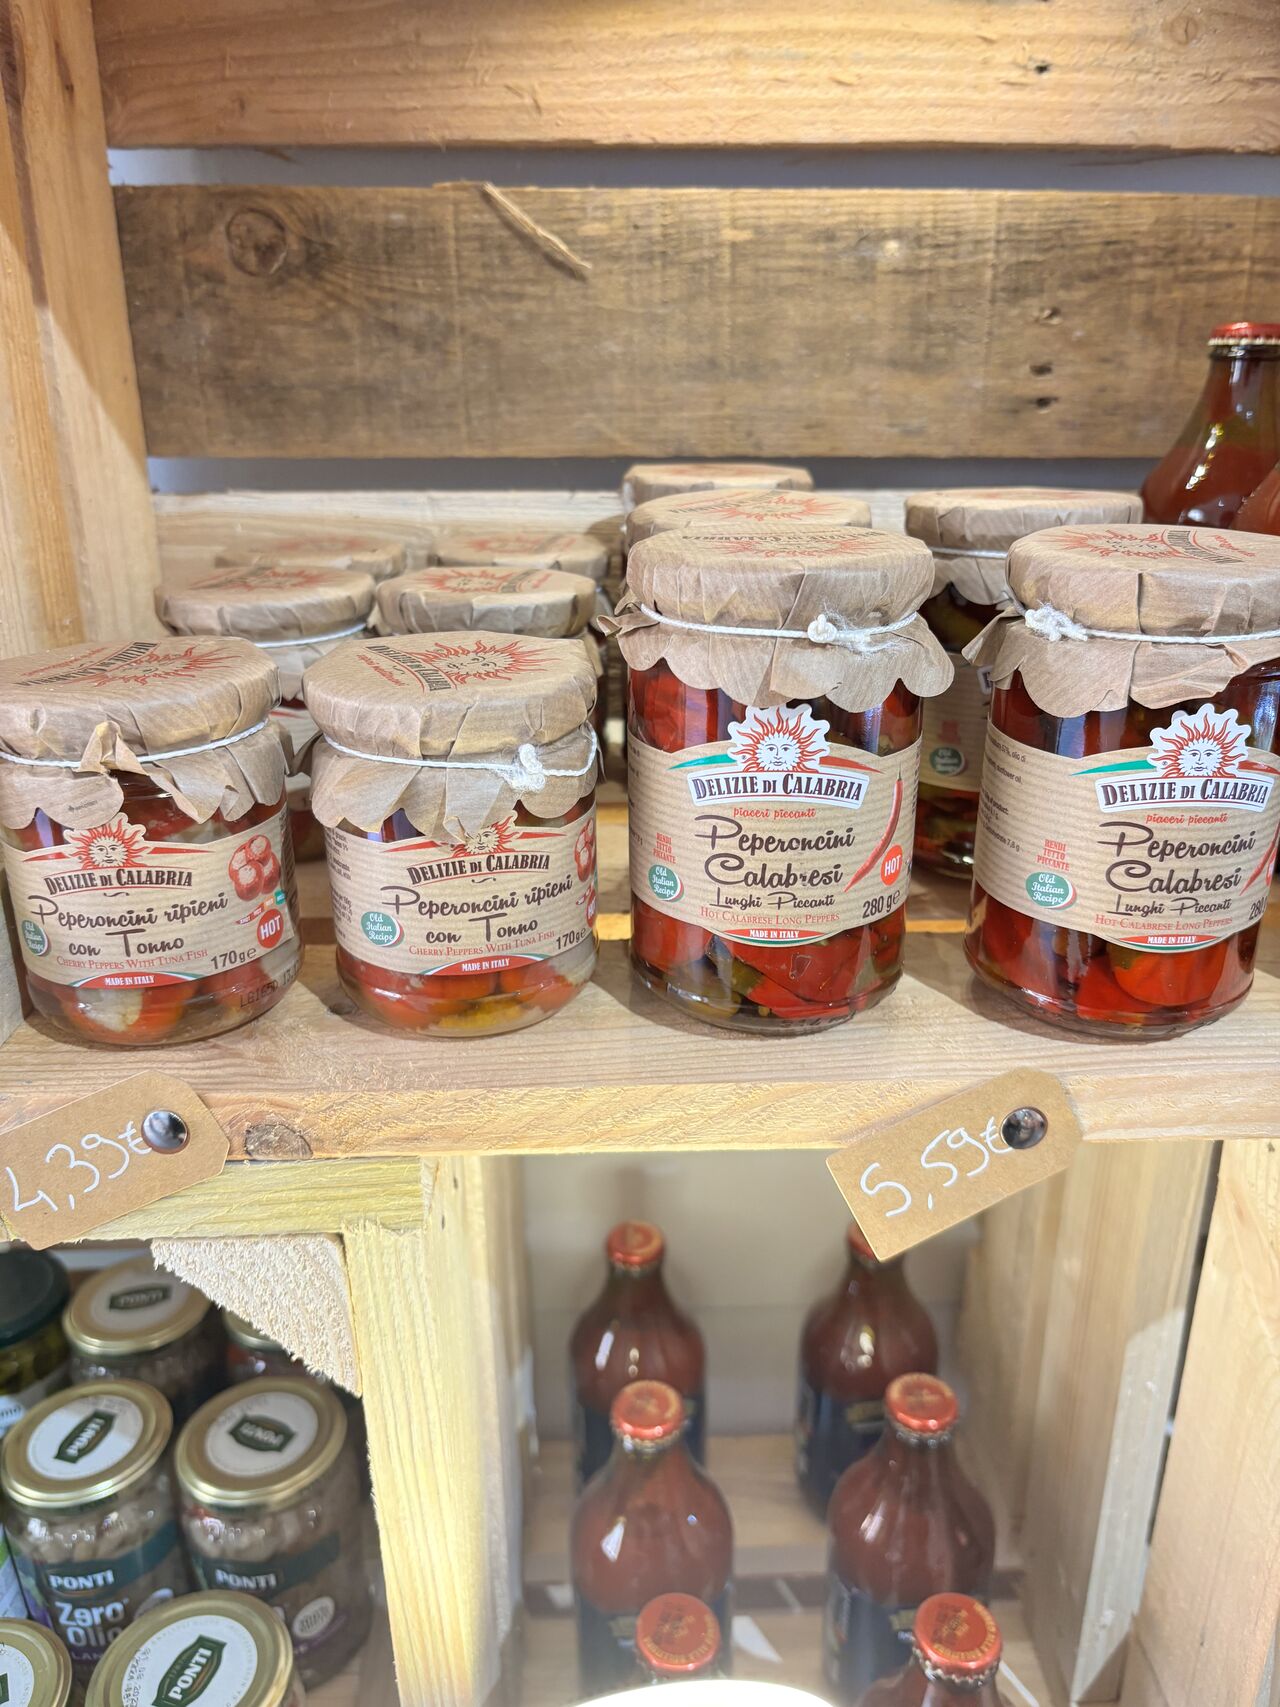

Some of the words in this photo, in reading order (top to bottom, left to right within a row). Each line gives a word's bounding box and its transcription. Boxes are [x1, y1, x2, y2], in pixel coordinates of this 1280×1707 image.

[692, 775, 759, 799] DELIZIE
[763, 780, 777, 792] DI
[782, 774, 863, 801] CALABRIA
[1101, 780, 1177, 806] DELIZIE
[1181, 786, 1195, 799] DI
[1200, 779, 1269, 804] CALABRIA
[733, 807, 769, 820] piaceri
[774, 807, 816, 820] piccanti
[1145, 813, 1184, 825] piaceri
[1188, 812, 1228, 825] piccanti
[694, 814, 855, 856] Peperoncini
[1044, 839, 1067, 852] RENDI
[1098, 821, 1256, 862] Peperoncini
[407, 860, 467, 885] DELIZIE
[470, 861, 481, 872] DI
[486, 854, 550, 872] CALABRIA
[654, 866, 668, 876] Old
[704, 853, 844, 889] Calabresi
[884, 855, 902, 876] HOT
[1037, 855, 1070, 872] PICCANTE
[44, 872, 98, 895] DELIZIE
[100, 875, 113, 887] DI
[116, 868, 192, 887] CALABRIA
[652, 875, 675, 887] Italian
[1038, 873, 1056, 884] Old
[1105, 859, 1242, 894] Calabresi
[380, 886, 519, 919] Peperoncini
[524, 874, 573, 905] ripieni
[653, 885, 675, 897] Recipe
[1031, 882, 1065, 894] Italian
[1032, 891, 1065, 905] Recipe
[710, 887, 762, 911] Lunghi
[768, 891, 835, 910] Piccanti
[863, 895, 885, 919] 280
[1107, 894, 1165, 917] Lunghi
[1171, 897, 1232, 916] Piccanti
[28, 895, 158, 930] Peperoncini
[164, 892, 229, 923] ripieni
[369, 913, 384, 923] Old
[701, 906, 718, 920] HOT
[722, 909, 773, 925] CALABRESE
[776, 914, 802, 926] LONG
[805, 912, 840, 925] PEPPERS
[260, 915, 282, 940] HOT
[366, 921, 393, 932] Italian
[426, 931, 462, 943] con
[468, 912, 539, 942] Tonno
[1095, 914, 1118, 927] HOT
[1120, 918, 1172, 931] CALABRESE
[1175, 918, 1201, 930] LONG
[1202, 917, 1233, 929] PEPPERS
[69, 942, 101, 956] con
[105, 928, 184, 957] Tonno
[368, 930, 394, 943] Recipe
[409, 945, 444, 956] CHERRY
[446, 946, 484, 956] PEPPERS
[486, 943, 511, 953] WITH
[513, 938, 536, 949] TUNA
[538, 931, 555, 942] FISH
[749, 930, 769, 939] MADE
[770, 930, 778, 938] IN
[779, 929, 800, 938] ITALY
[1147, 936, 1167, 944] MADE
[1177, 935, 1197, 943] ITALY
[57, 956, 87, 969] CHERRY
[89, 958, 125, 969] PEPPERS
[126, 958, 155, 969] WITH
[158, 955, 185, 966] TUNA
[187, 949, 209, 960] FISH
[462, 961, 481, 972] MADE
[482, 961, 490, 970] IN
[491, 958, 511, 969] ITALY
[105, 976, 125, 985] MADE
[126, 976, 132, 984] IN
[133, 975, 155, 984] ITALY
[6, 1120, 153, 1212] 4,39€
[860, 1116, 1015, 1217] 5,59€
[49, 1569, 115, 1590] PONTI
[214, 1568, 278, 1590] PONTI
[167, 1647, 213, 1701] PONTI
